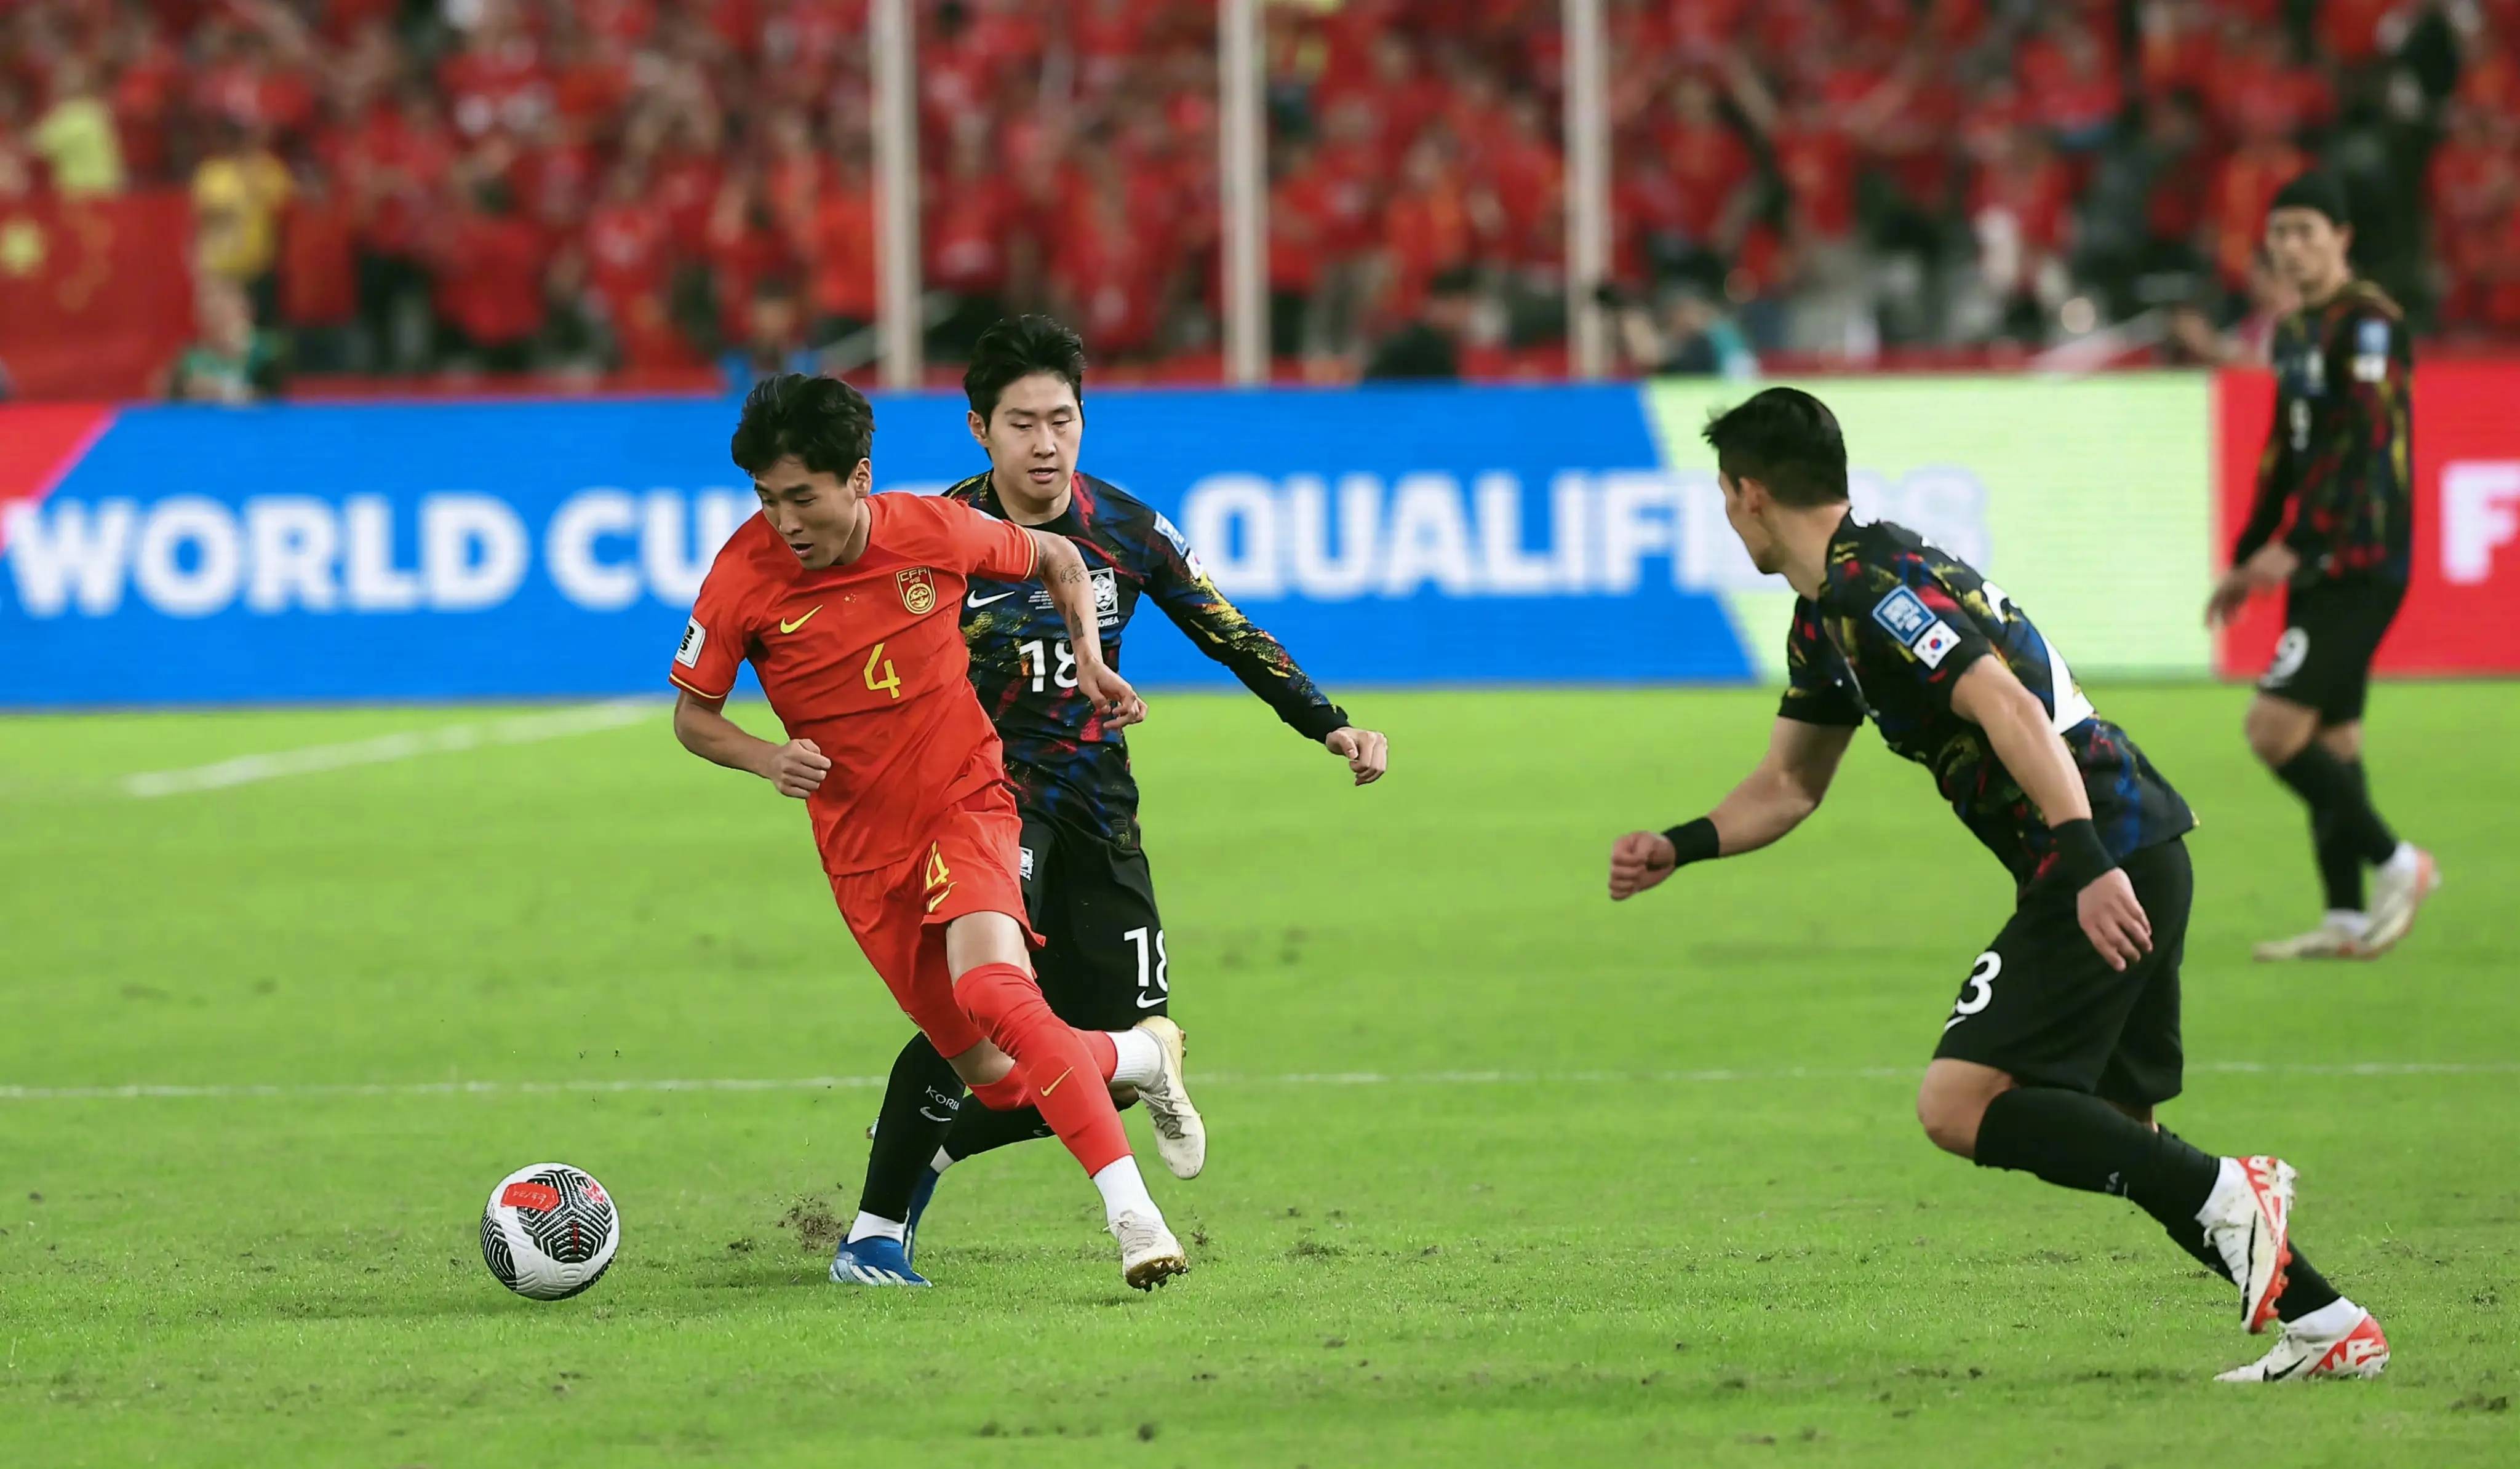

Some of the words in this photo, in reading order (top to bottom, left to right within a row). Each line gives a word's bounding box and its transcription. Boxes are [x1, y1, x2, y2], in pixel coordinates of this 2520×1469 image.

[2, 495, 529, 615] WORLD
[545, 488, 764, 610] CU
[1182, 464, 1991, 599] QUALIFIS
[899, 567, 927, 583] CFA
[1098, 616, 1120, 627] OREA
[863, 642, 901, 699] 4
[1019, 639, 1079, 693] 18
[925, 840, 950, 891] 4
[1956, 950, 2002, 1015] 3
